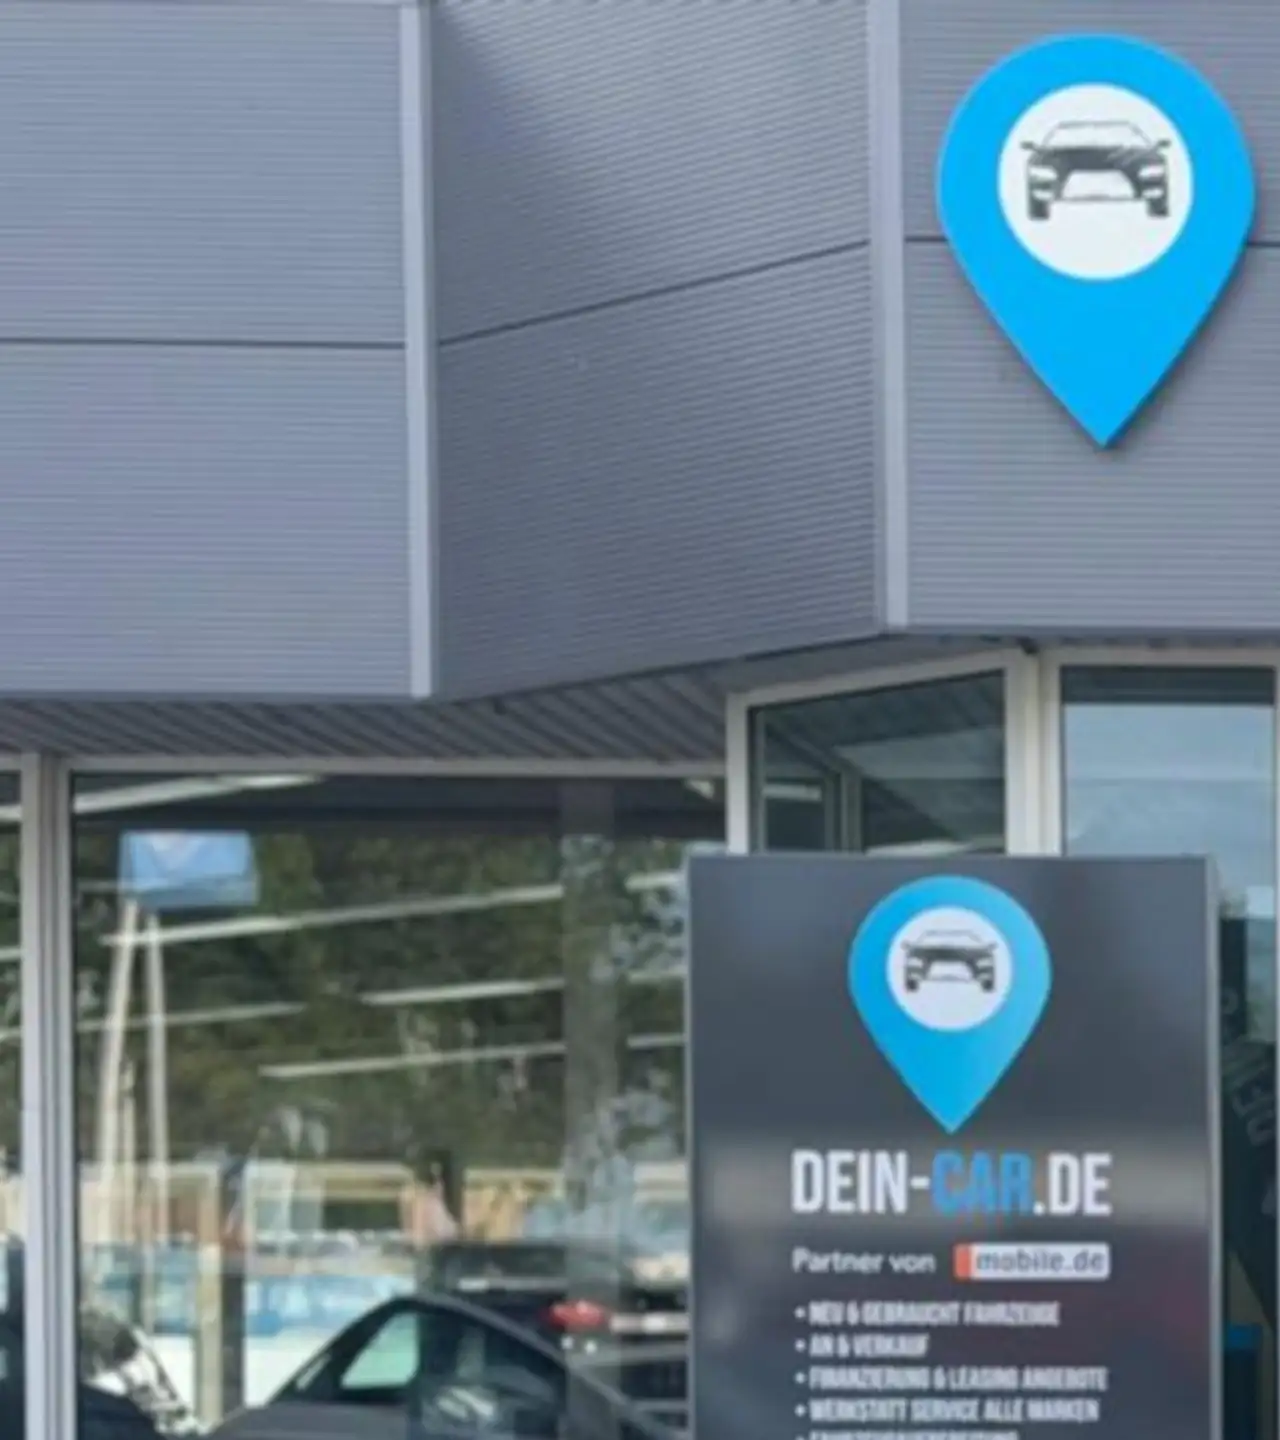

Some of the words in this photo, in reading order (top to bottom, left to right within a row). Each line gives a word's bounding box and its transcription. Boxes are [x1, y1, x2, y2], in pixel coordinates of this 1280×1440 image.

[790, 1149, 1113, 1217] DEIN-CAR.DE
[792, 1246, 883, 1275] Partner
[888, 1251, 937, 1275] von
[974, 1247, 1106, 1275] mobile.de
[853, 1333, 929, 1358] VERKAUF
[948, 1366, 1019, 1391] LEASING
[910, 1398, 980, 1423] SERVICE
[982, 1398, 1024, 1423] ALLE
[1026, 1398, 1100, 1423] MARKEN
